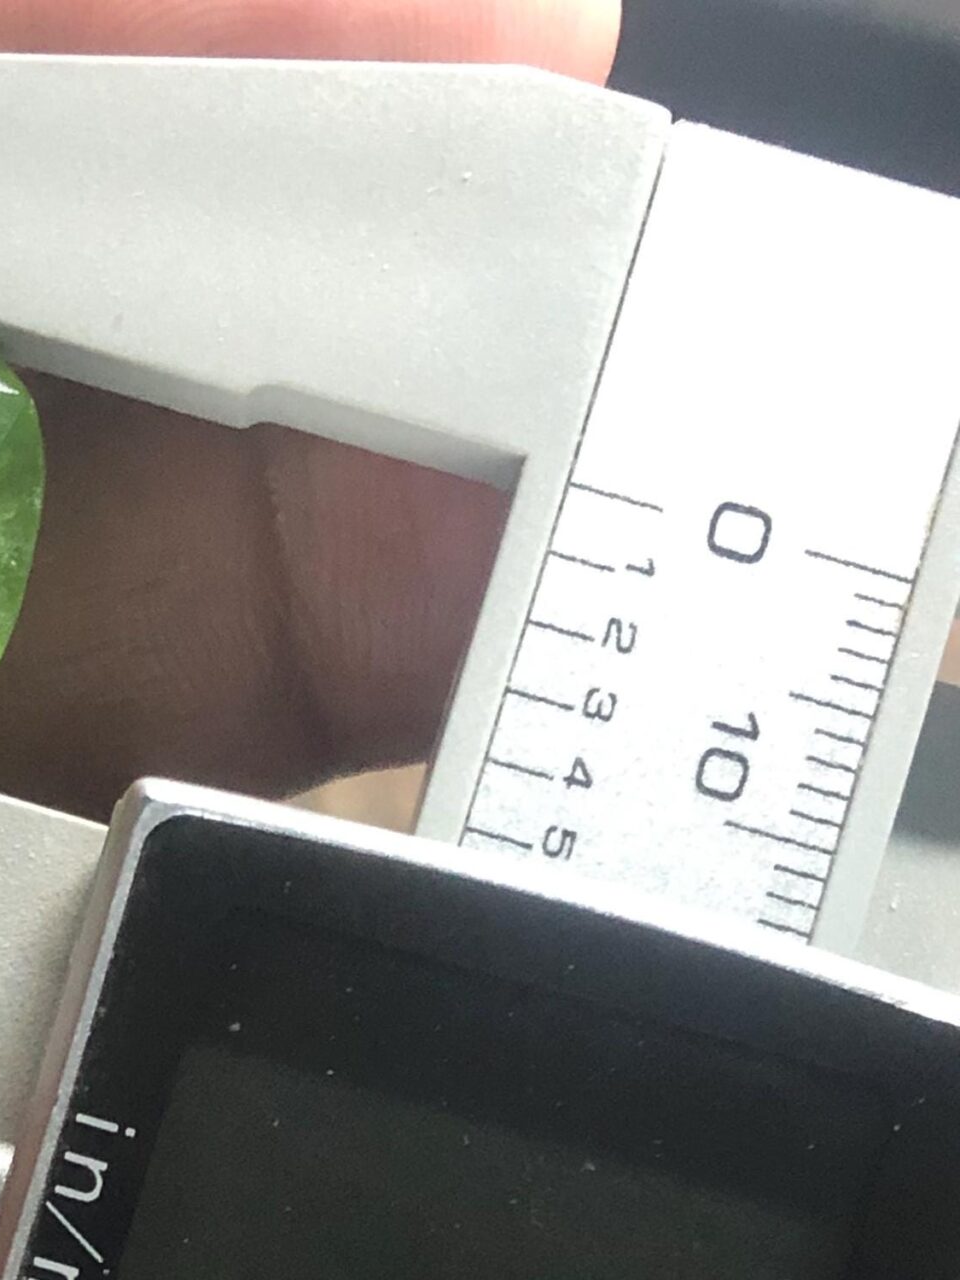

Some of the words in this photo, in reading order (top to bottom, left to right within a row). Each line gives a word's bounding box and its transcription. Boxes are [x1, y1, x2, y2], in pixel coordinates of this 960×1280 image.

[708, 502, 771, 563] 0
[626, 559, 655, 576] 1
[602, 617, 636, 654] 2
[584, 688, 616, 721] 3
[563, 757, 592, 788] 4
[696, 713, 760, 801] 10
[543, 825, 576, 860] 5
